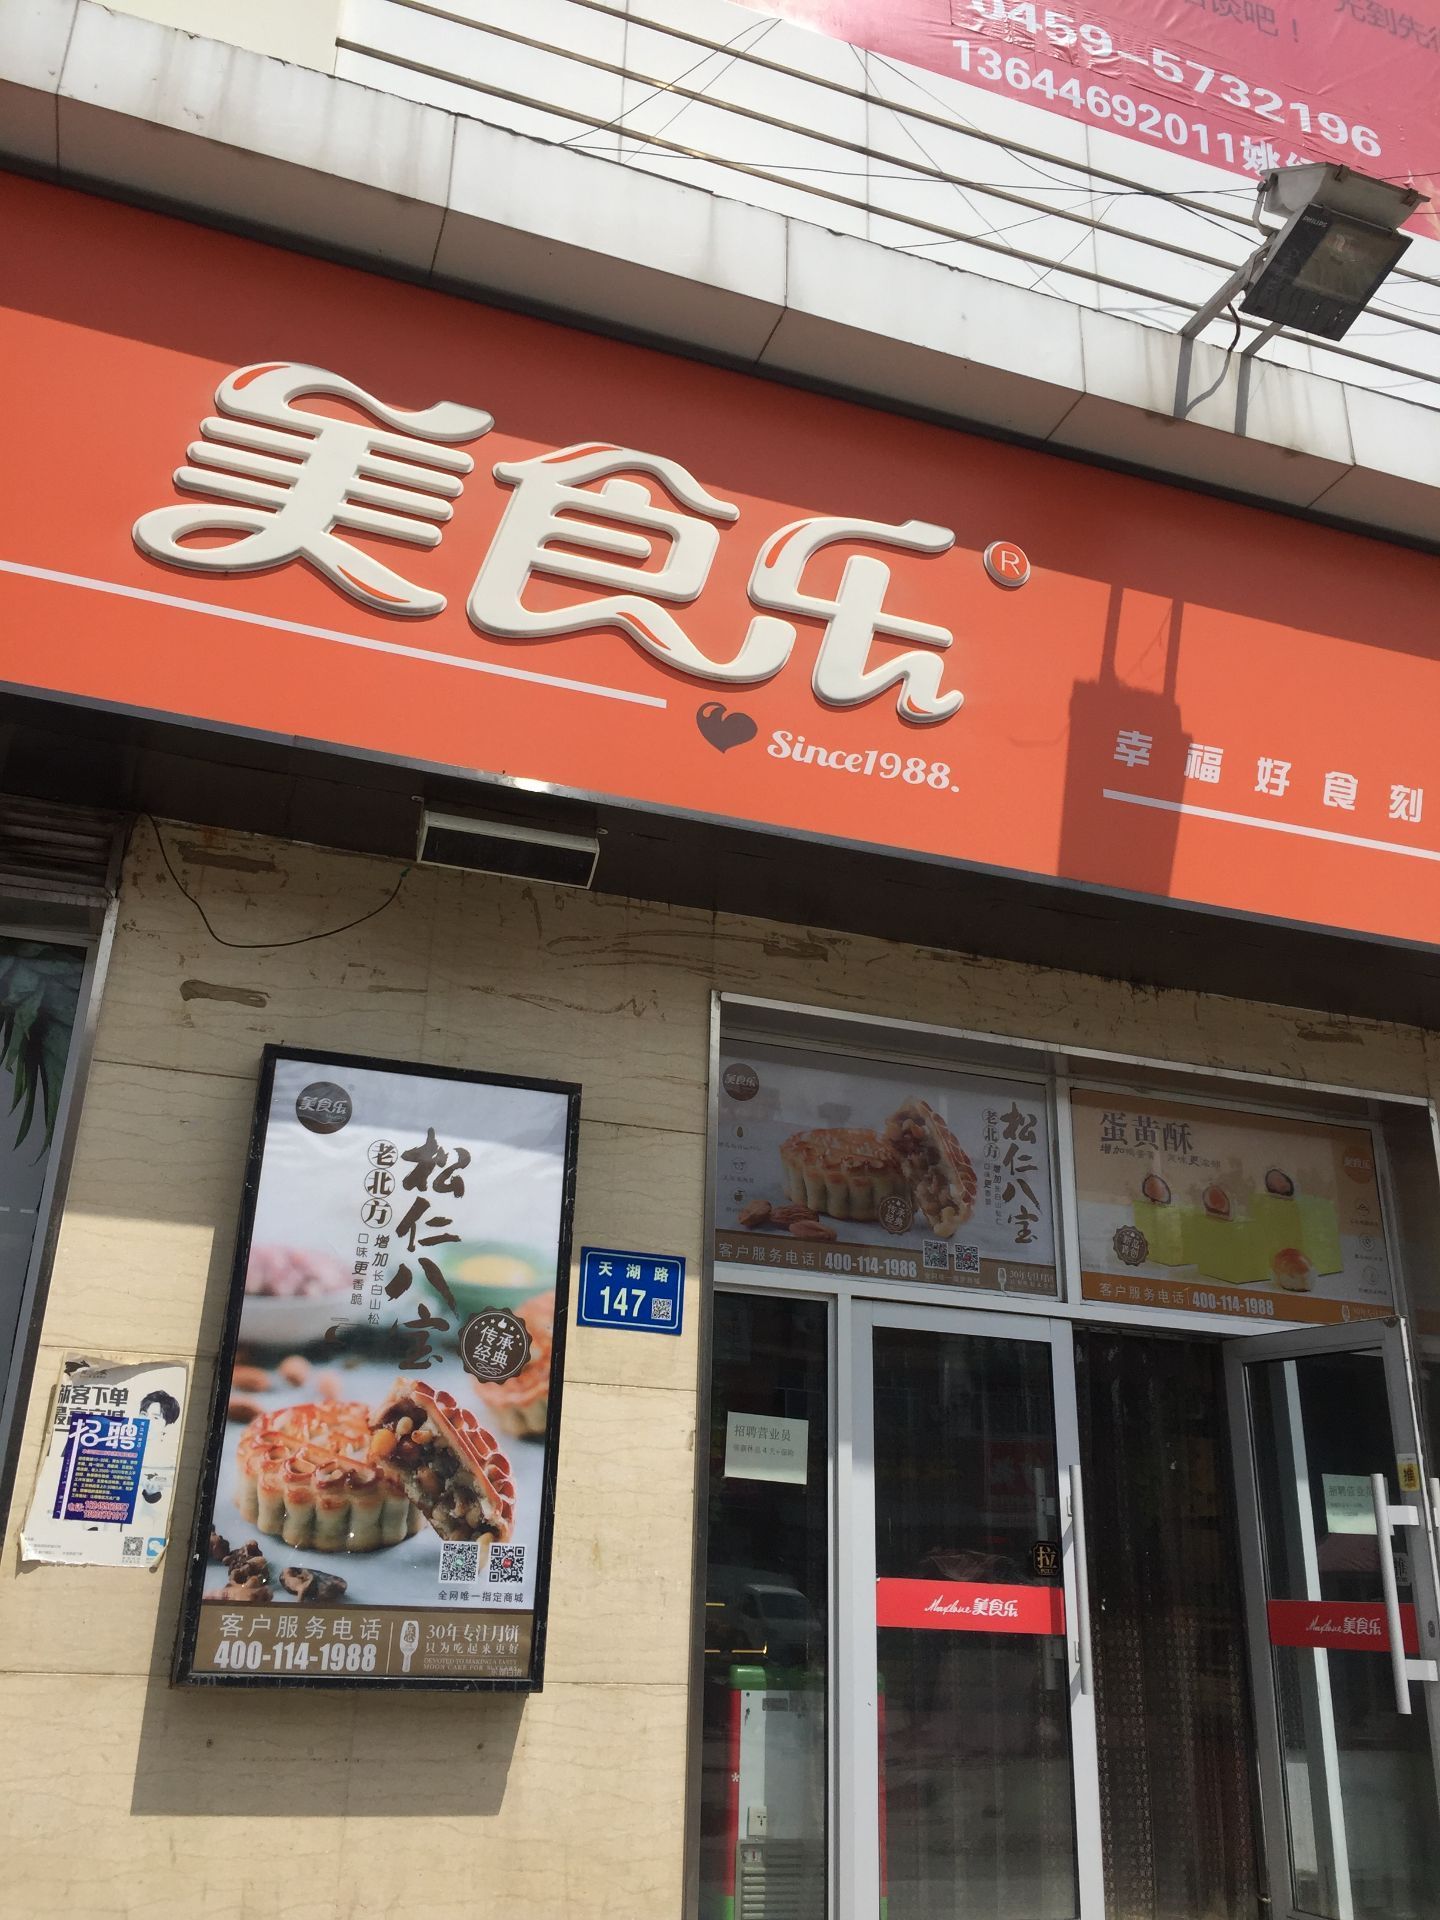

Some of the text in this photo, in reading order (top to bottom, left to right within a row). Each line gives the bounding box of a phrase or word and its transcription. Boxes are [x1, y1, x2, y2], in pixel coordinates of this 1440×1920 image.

[131, 361, 965, 724] 美食乐
[1112, 730, 1424, 825] 幸福好食刻
[1099, 1111, 1194, 1155] 蛋黄酥
[362, 1140, 399, 1228] 老北方
[718, 1242, 815, 1266] 客户服务电话
[824, 1252, 918, 1279] 400-114-1988
[598, 1260, 670, 1284] 天湖路
[599, 1285, 648, 1318] 147
[1098, 1282, 1185, 1305] 客户服务电话
[1192, 1291, 1275, 1316] 400-114-1988
[480, 1325, 515, 1351] 传承
[472, 1342, 509, 1370] 经典
[68, 1417, 138, 1450] 招聘
[734, 1424, 792, 1442] 招聘营业员
[1036, 1545, 1059, 1569] 拉
[437, 1589, 525, 1604] 全网唯一指定商城
[972, 1597, 1019, 1618] 美食乐
[218, 1613, 383, 1642] 客户服务电话
[425, 1623, 521, 1644] 30年专注月饼
[1343, 1617, 1382, 1635] 美食乐
[212, 1640, 378, 1672] 400-114-1988
